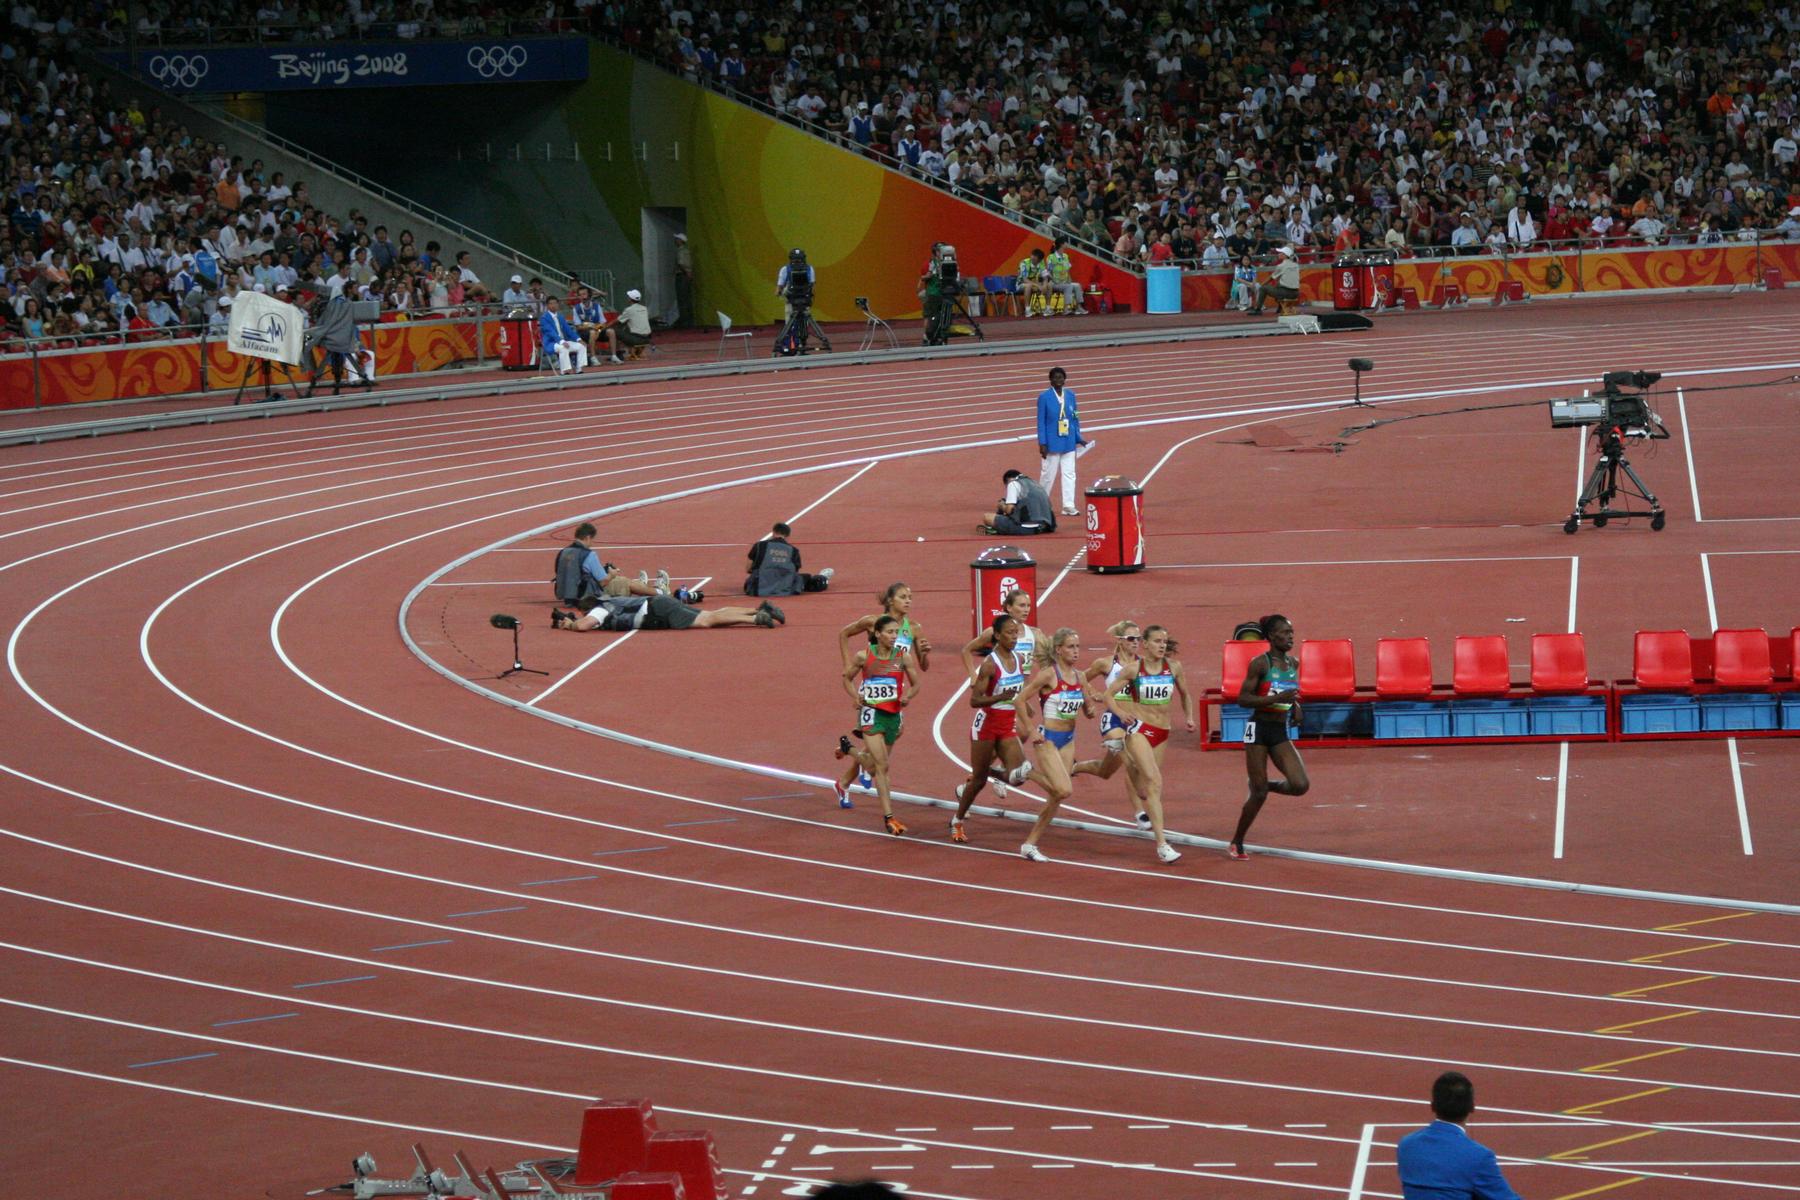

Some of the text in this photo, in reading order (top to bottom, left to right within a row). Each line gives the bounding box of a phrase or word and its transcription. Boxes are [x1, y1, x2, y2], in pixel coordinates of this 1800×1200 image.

[269, 52, 408, 85] Beijing 2008
[240, 340, 279, 353] Alfacam
[867, 686, 894, 699] 2383
[1145, 686, 1168, 699] 1146
[863, 709, 871, 723] 6
[974, 713, 983, 728] 8
[1245, 724, 1253, 740] 4
